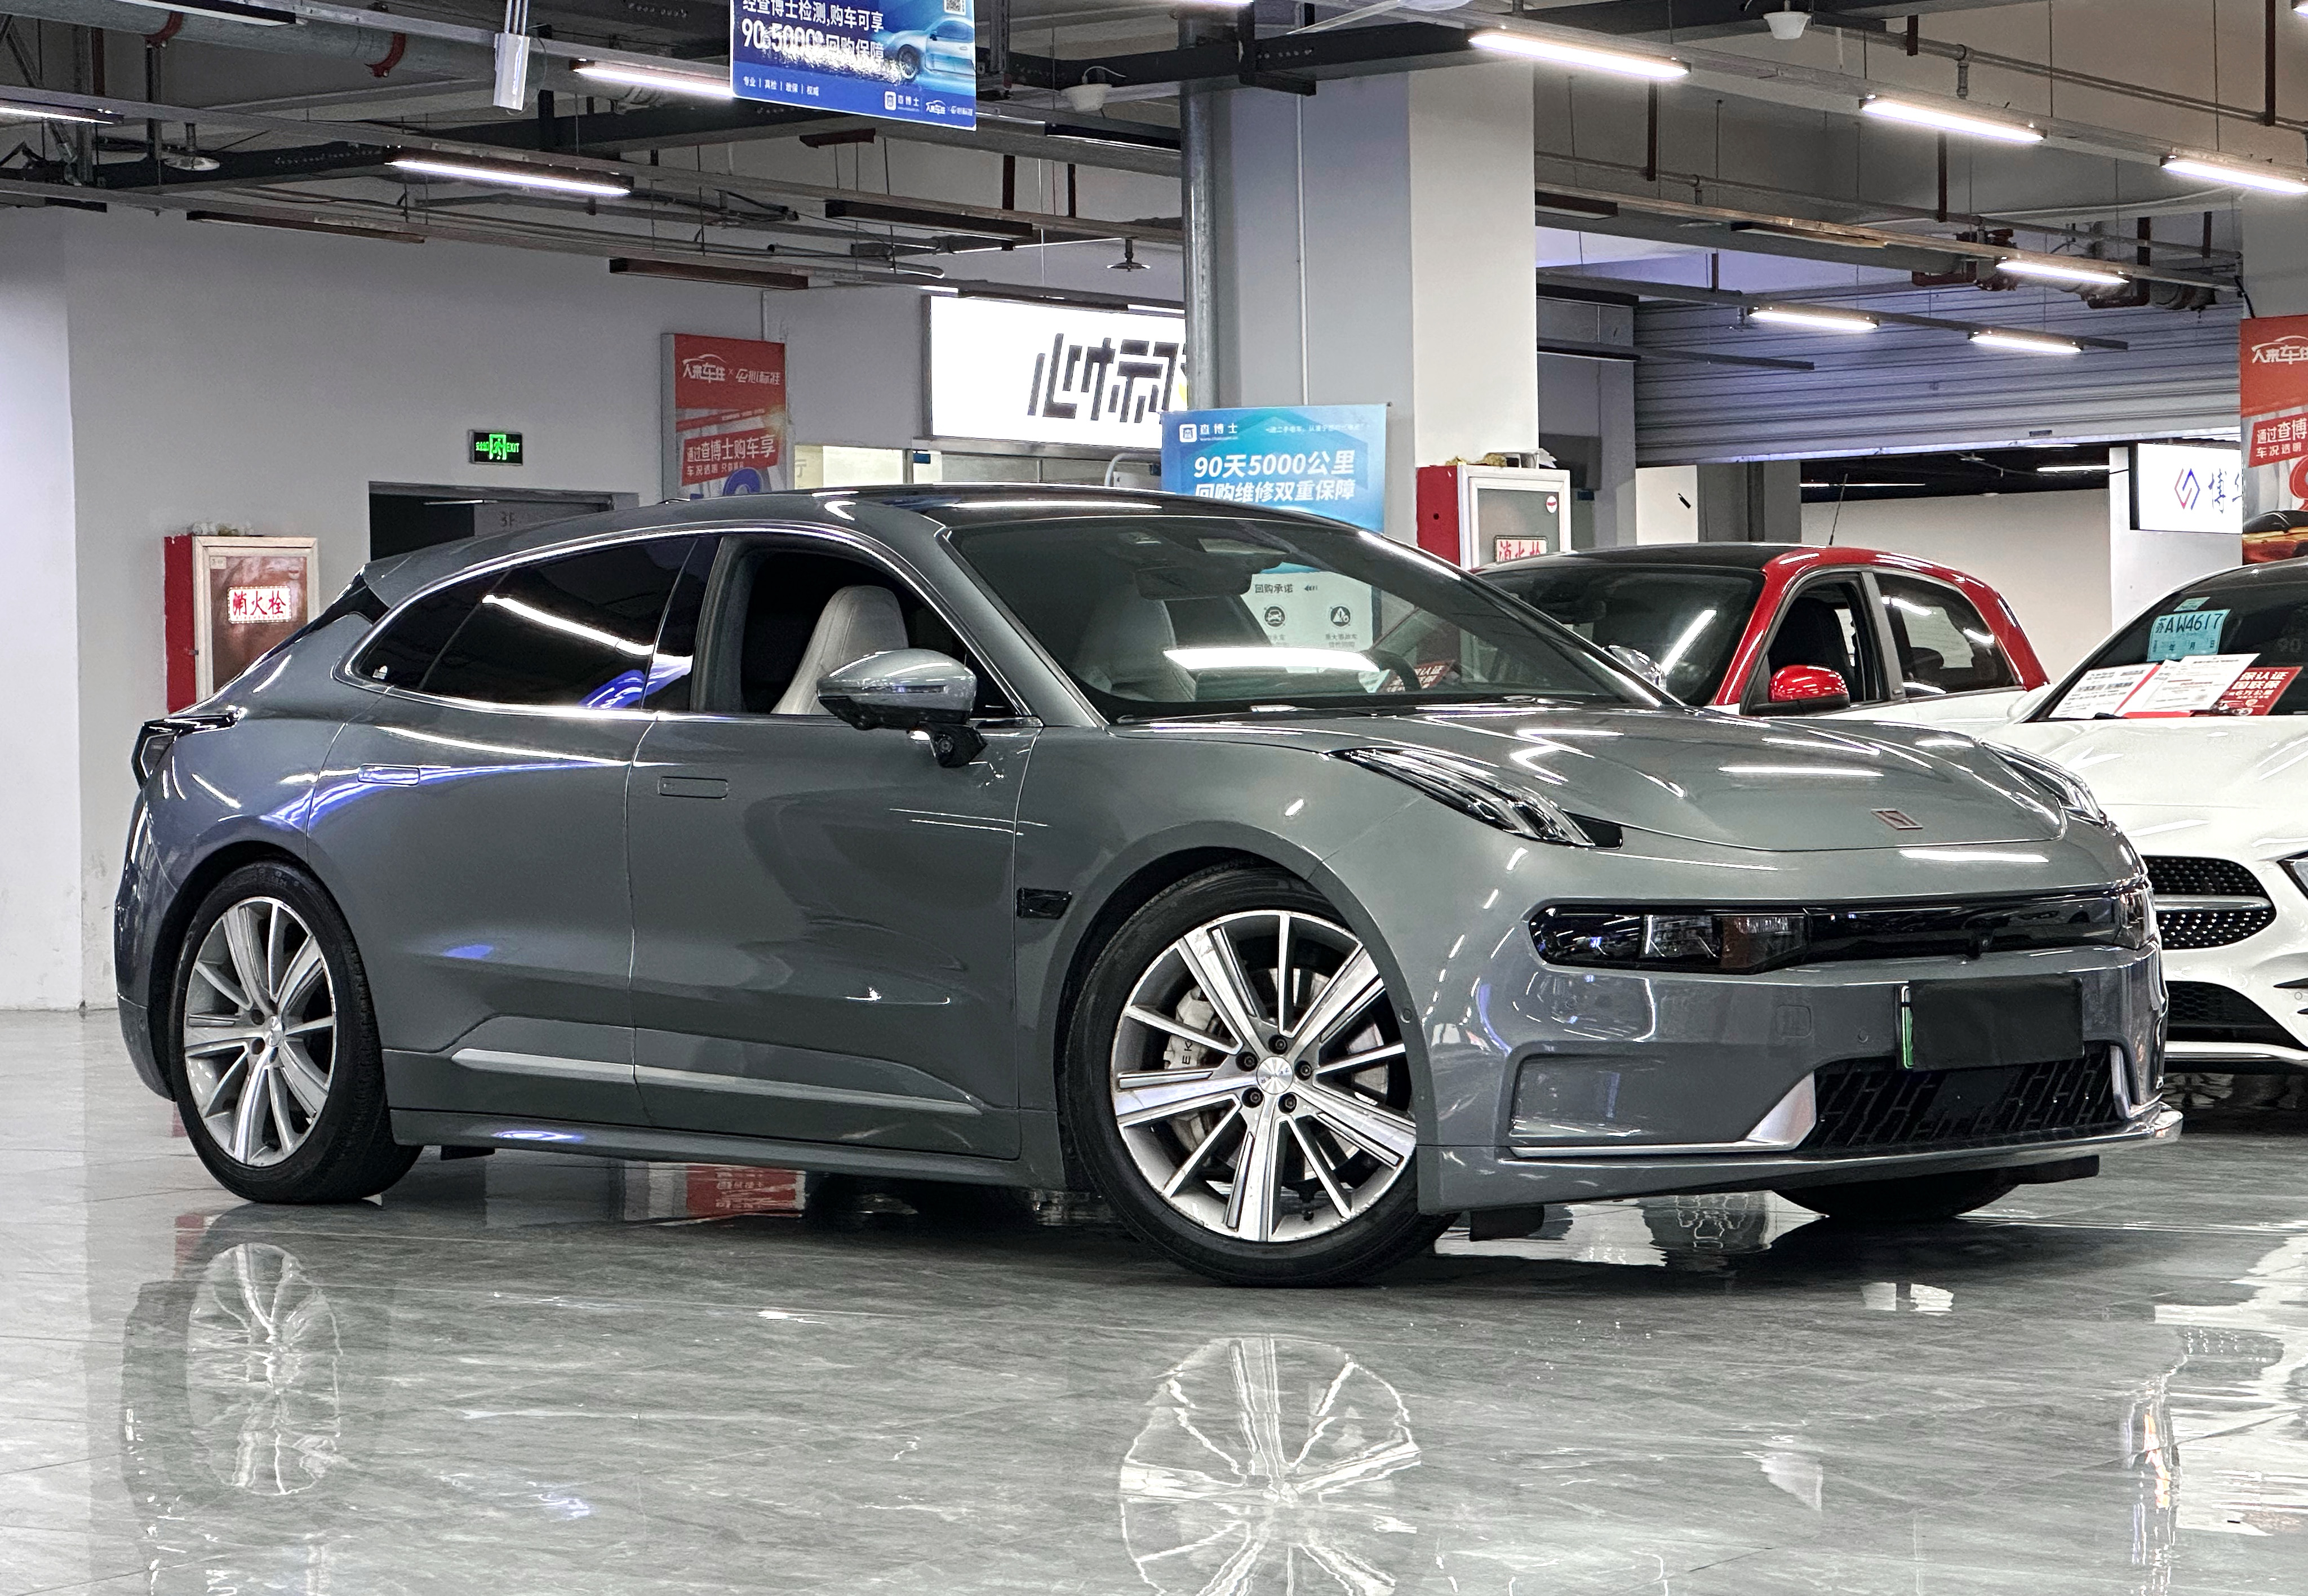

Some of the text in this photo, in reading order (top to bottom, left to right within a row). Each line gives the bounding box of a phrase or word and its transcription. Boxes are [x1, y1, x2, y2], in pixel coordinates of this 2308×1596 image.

[1199, 423, 1238, 435] 查博士
[2257, 417, 2308, 444] 通过查博
[507, 442, 520, 453] EXIT
[687, 434, 776, 463] 通过查博士购车享
[2256, 442, 2302, 459] 车况透明
[1193, 450, 1355, 478] 90天5000公里
[1195, 479, 1356, 503] 回购维修双重保障
[1255, 584, 1293, 593] 回购承诺
[232, 590, 286, 616] 消火栓
